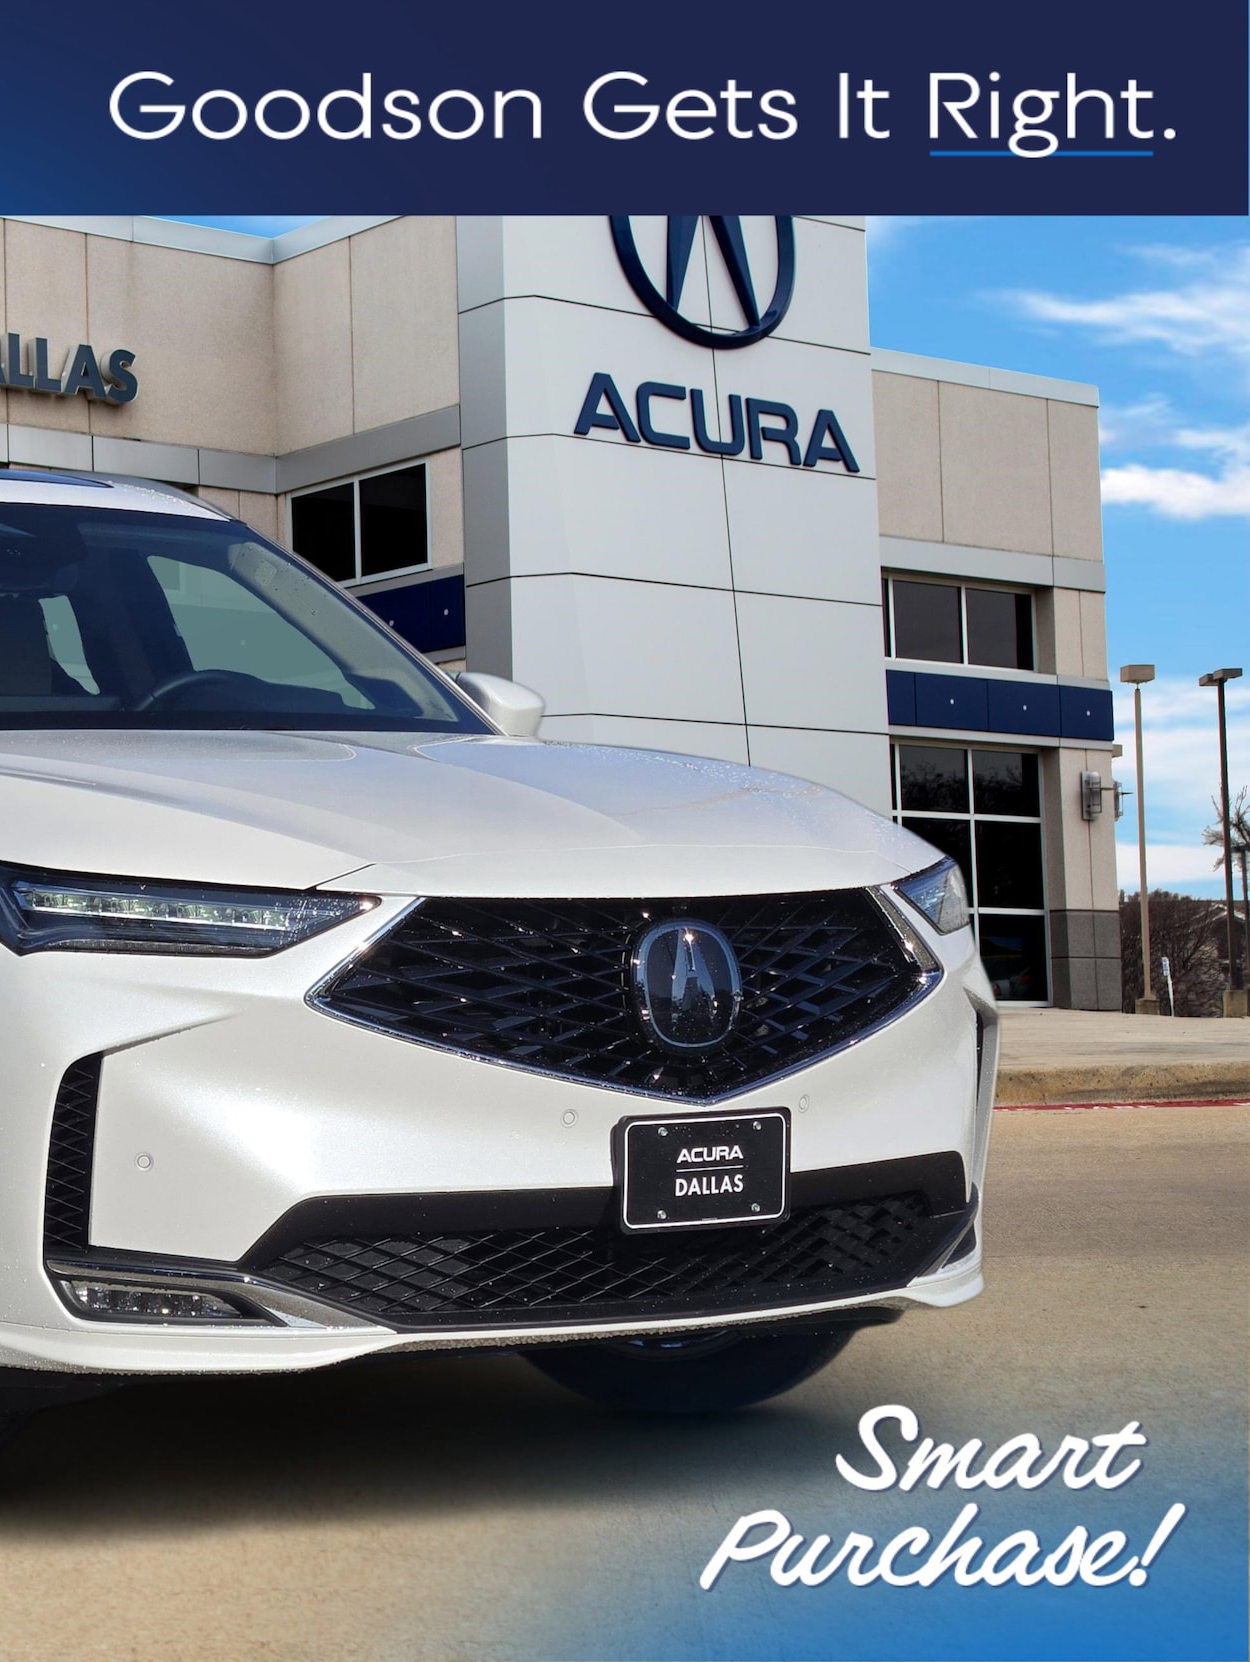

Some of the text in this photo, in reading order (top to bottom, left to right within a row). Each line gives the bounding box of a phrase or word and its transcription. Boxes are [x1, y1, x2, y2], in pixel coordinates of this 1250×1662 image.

[574, 373, 860, 473] ACURA
[676, 1145, 744, 1163] ACURA
[675, 1174, 744, 1197] DALLAS
